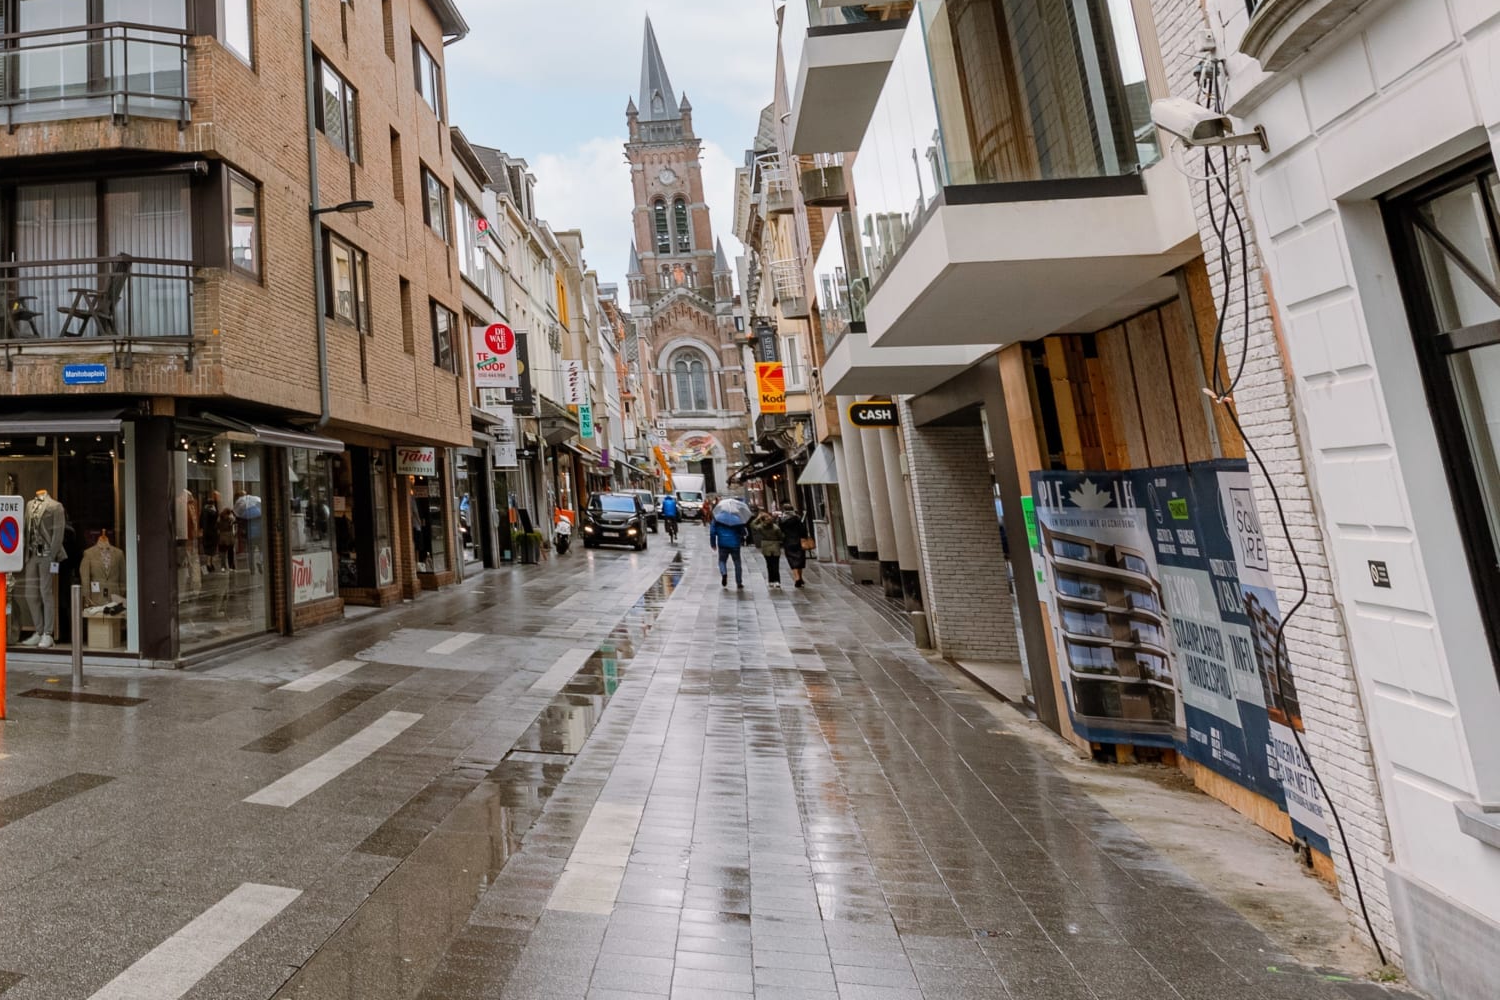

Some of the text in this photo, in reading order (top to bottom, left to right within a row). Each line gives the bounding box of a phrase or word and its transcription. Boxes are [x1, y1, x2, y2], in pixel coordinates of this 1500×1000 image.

[476, 352, 489, 360] TE
[580, 407, 590, 428] MEN
[859, 409, 892, 420] CASH
[398, 450, 433, 464] Tani
[0, 502, 18, 512] ZONE
[1229, 634, 1254, 674] INFO
